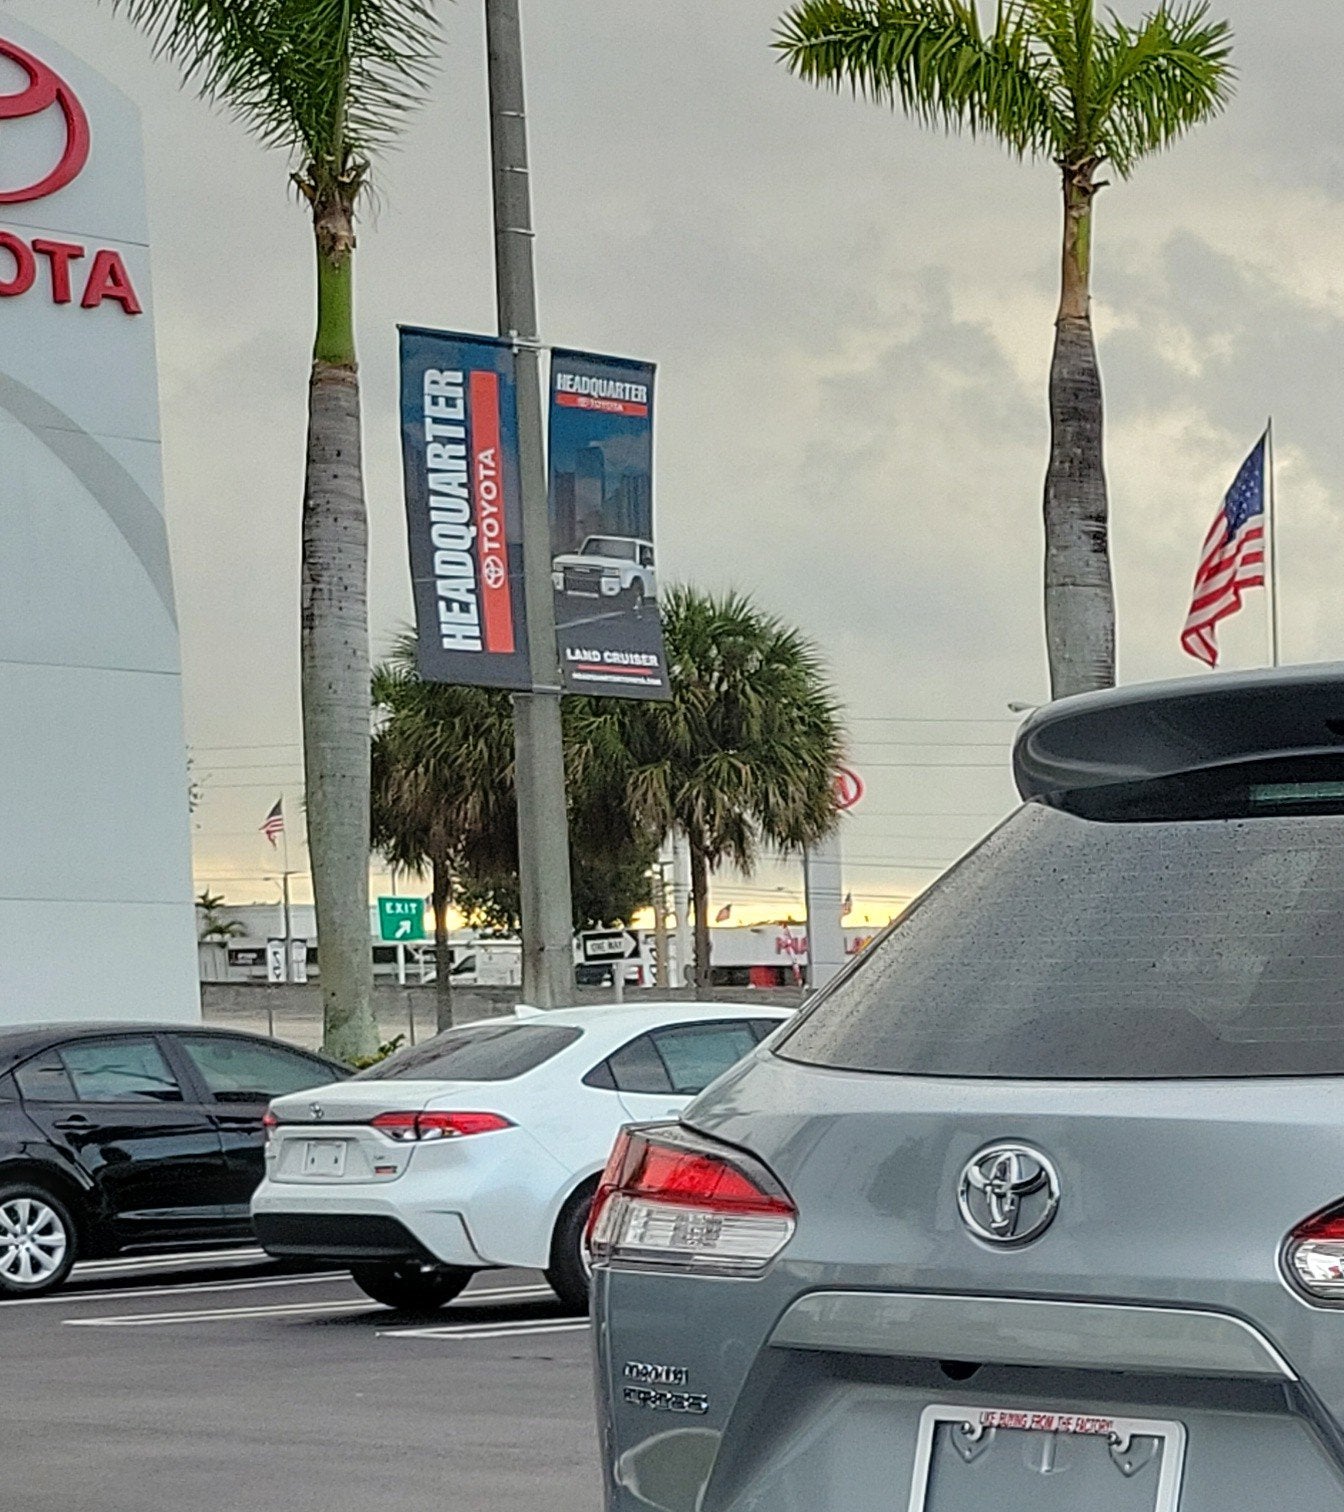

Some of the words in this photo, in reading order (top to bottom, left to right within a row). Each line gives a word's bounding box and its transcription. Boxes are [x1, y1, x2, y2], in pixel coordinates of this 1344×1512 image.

[557, 373, 647, 403] HEADQUARTER
[424, 368, 482, 651] HEADQUARTER
[479, 448, 503, 553] TOYOTA
[566, 647, 601, 661] LAND
[603, 650, 660, 667] CRUISER
[385, 902, 418, 914] EXIT
